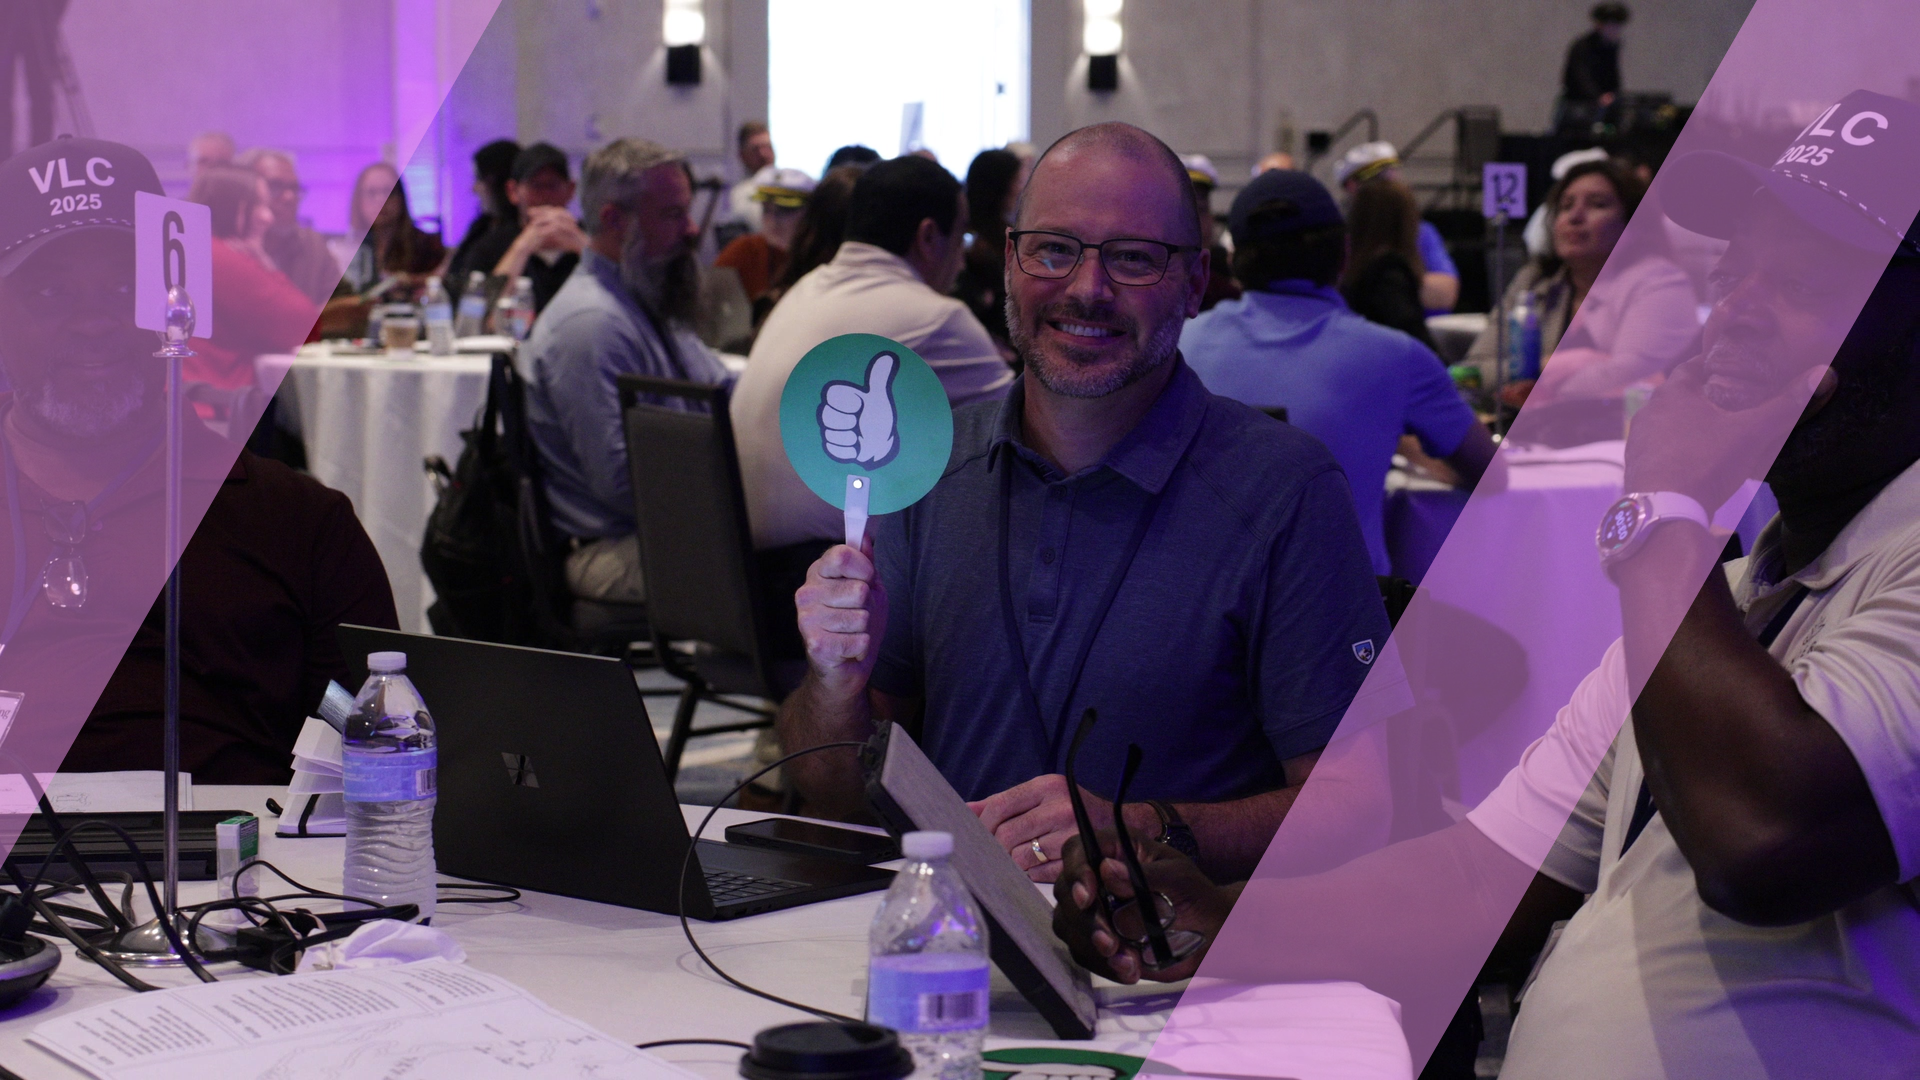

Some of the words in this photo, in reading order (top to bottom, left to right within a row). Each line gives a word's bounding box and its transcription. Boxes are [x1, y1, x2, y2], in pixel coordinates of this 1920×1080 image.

[28, 157, 115, 194] VLC
[1492, 173, 1518, 204] 12
[50, 194, 102, 216] 2025
[162, 210, 186, 294] 6
